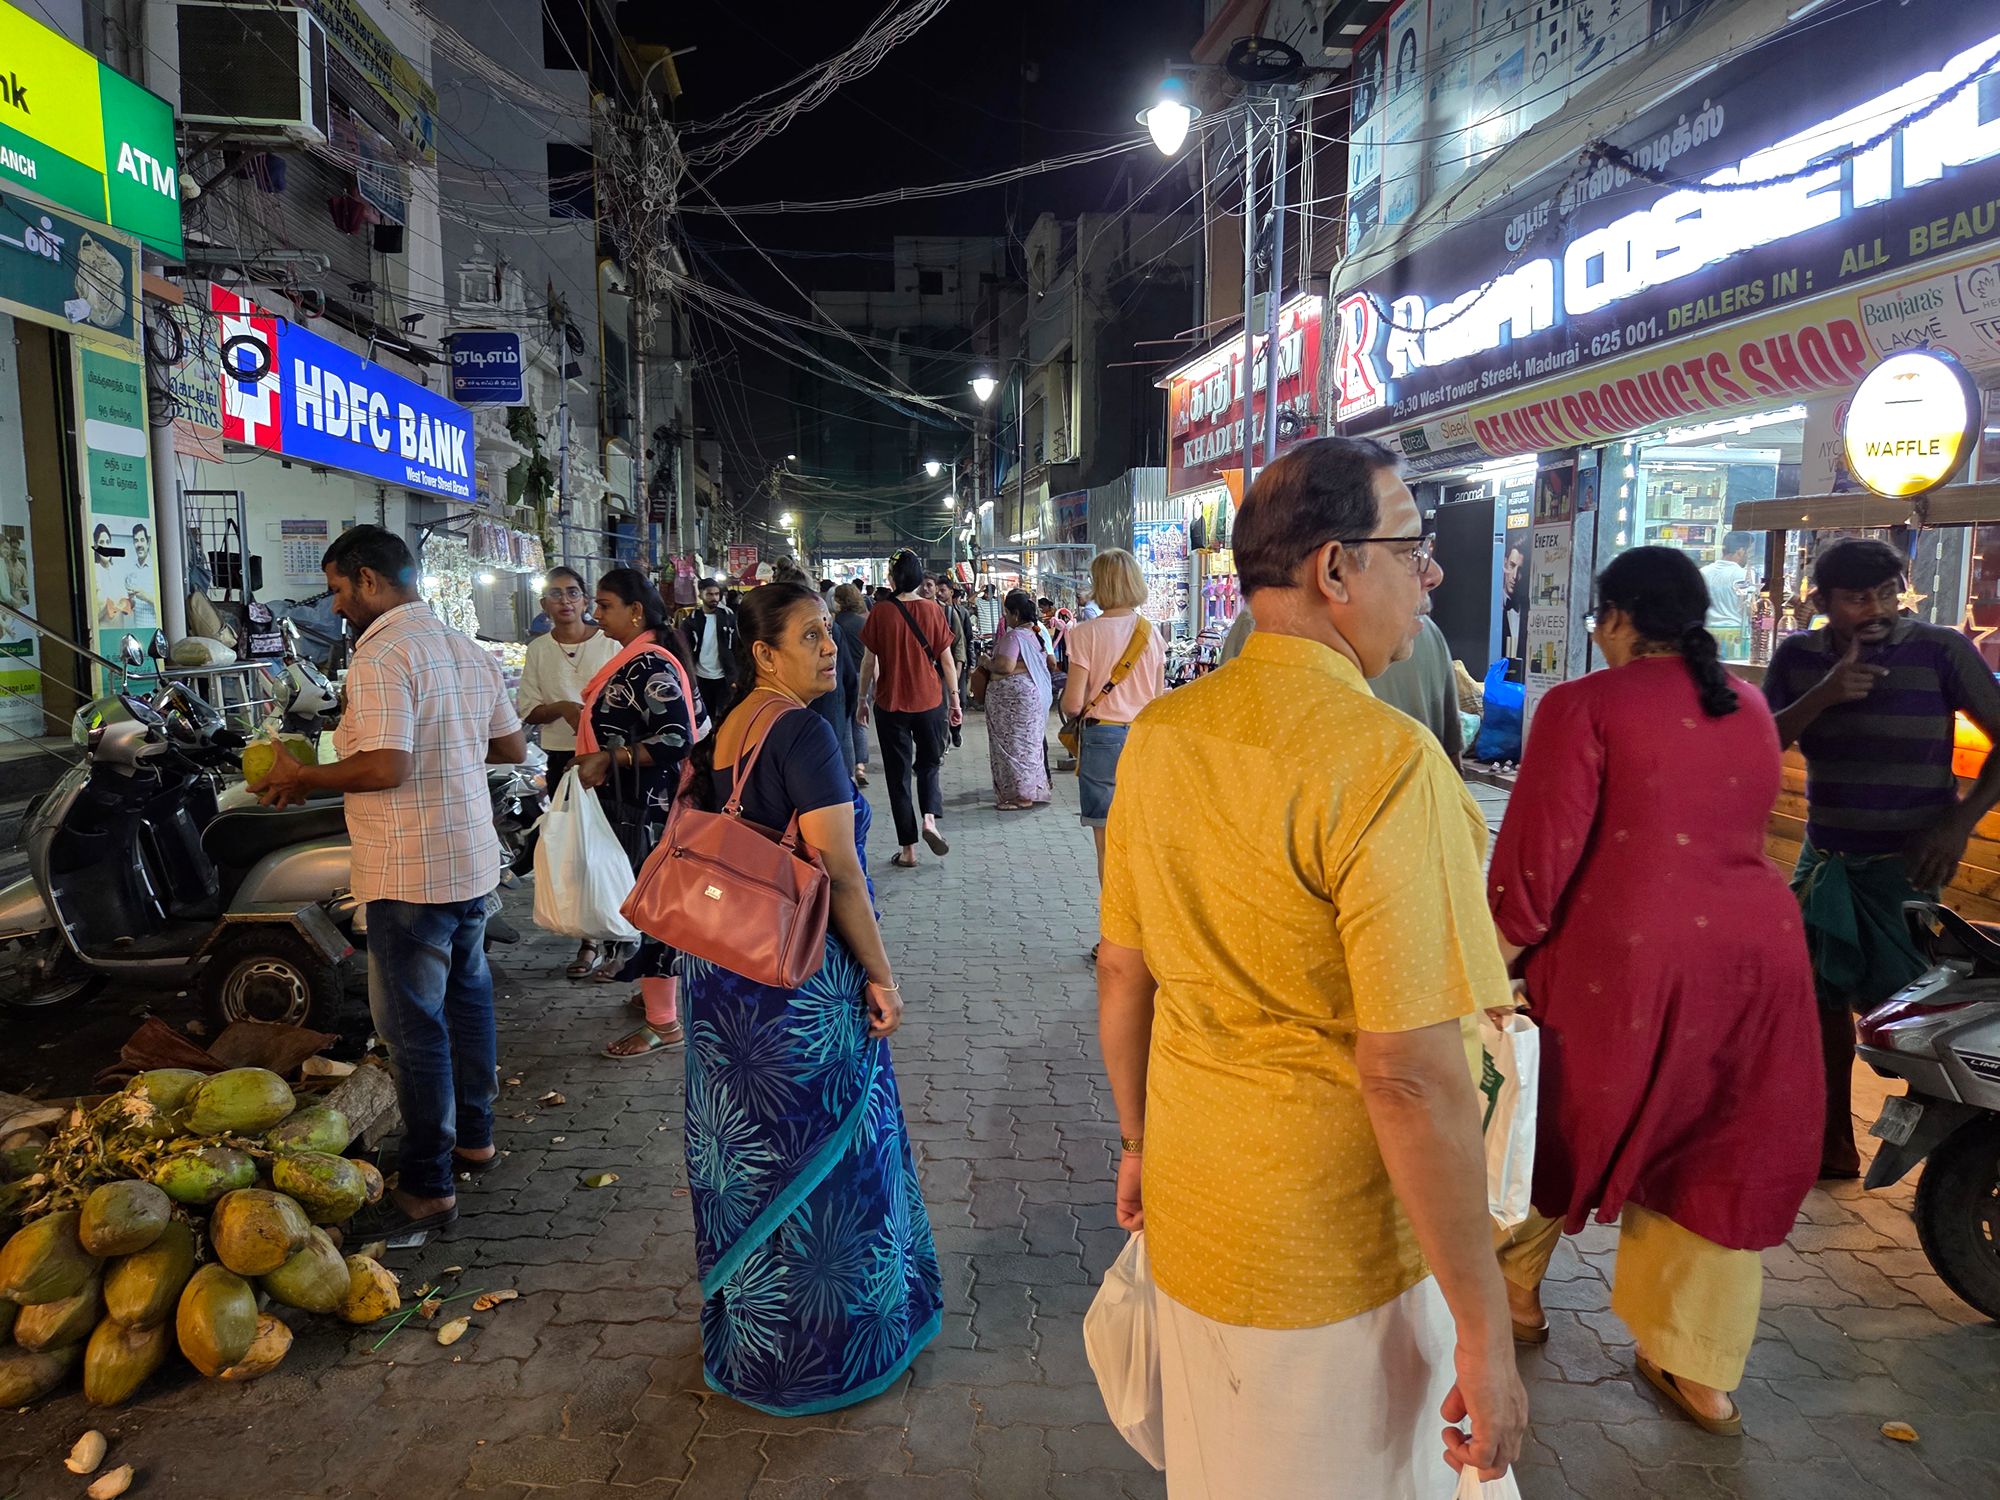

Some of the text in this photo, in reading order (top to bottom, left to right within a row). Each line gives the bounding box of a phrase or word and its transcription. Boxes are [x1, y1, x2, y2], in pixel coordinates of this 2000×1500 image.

[117, 141, 176, 200] ATM
[1863, 287, 1944, 326] Banjara's
[1982, 298, 2000, 309] HE
[1393, 395, 1418, 418] 29,30
[1420, 384, 1445, 406] West
[1446, 377, 1478, 402] Tower
[1480, 361, 1522, 390] Street,
[1525, 342, 1580, 378] Madurai
[1591, 329, 1621, 357] 625
[1667, 278, 1764, 332] DEALERS
[1838, 237, 1891, 278] ALL
[1876, 316, 1948, 352] LAKMÉ
[454, 345, 518, 369] ஏடிஎம்
[1474, 318, 1868, 455] BEAUTY PRODUCTS SHOP
[294, 357, 469, 479] HDFC BANK
[1441, 414, 1471, 440] Sleek
[1183, 423, 1233, 469] KHADI
[1865, 439, 1940, 457] WAFFLE
[405, 466, 470, 497] West Tower Street Branch
[1534, 533, 1559, 548] EYETEX
[1530, 615, 1565, 628] JOVEES
